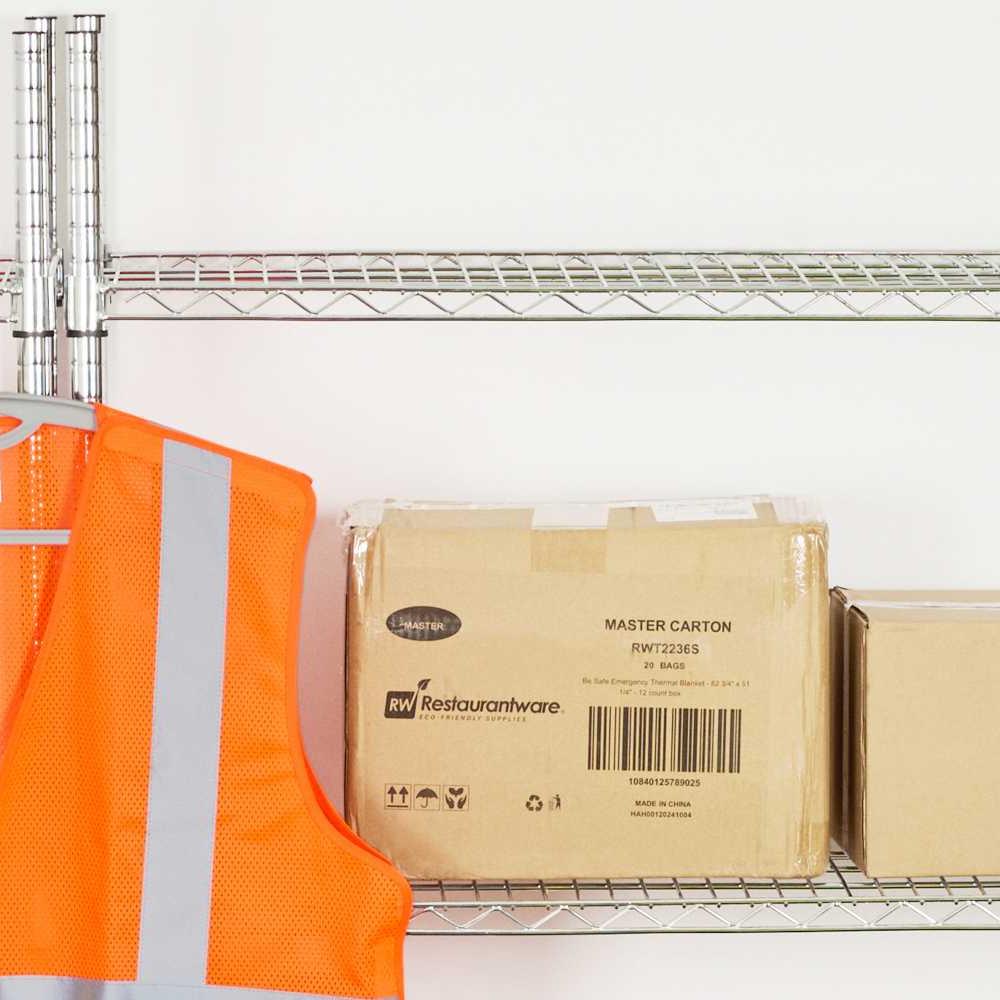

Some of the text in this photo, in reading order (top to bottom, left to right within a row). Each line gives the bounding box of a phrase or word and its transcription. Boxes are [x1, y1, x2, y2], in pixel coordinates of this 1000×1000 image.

[403, 621, 444, 631] MASTER
[605, 619, 732, 633] MASTER CARTON
[631, 642, 700, 655] RWT2236S
[660, 662, 686, 670] BAGS
[388, 695, 561, 714] RW Restaurantware
